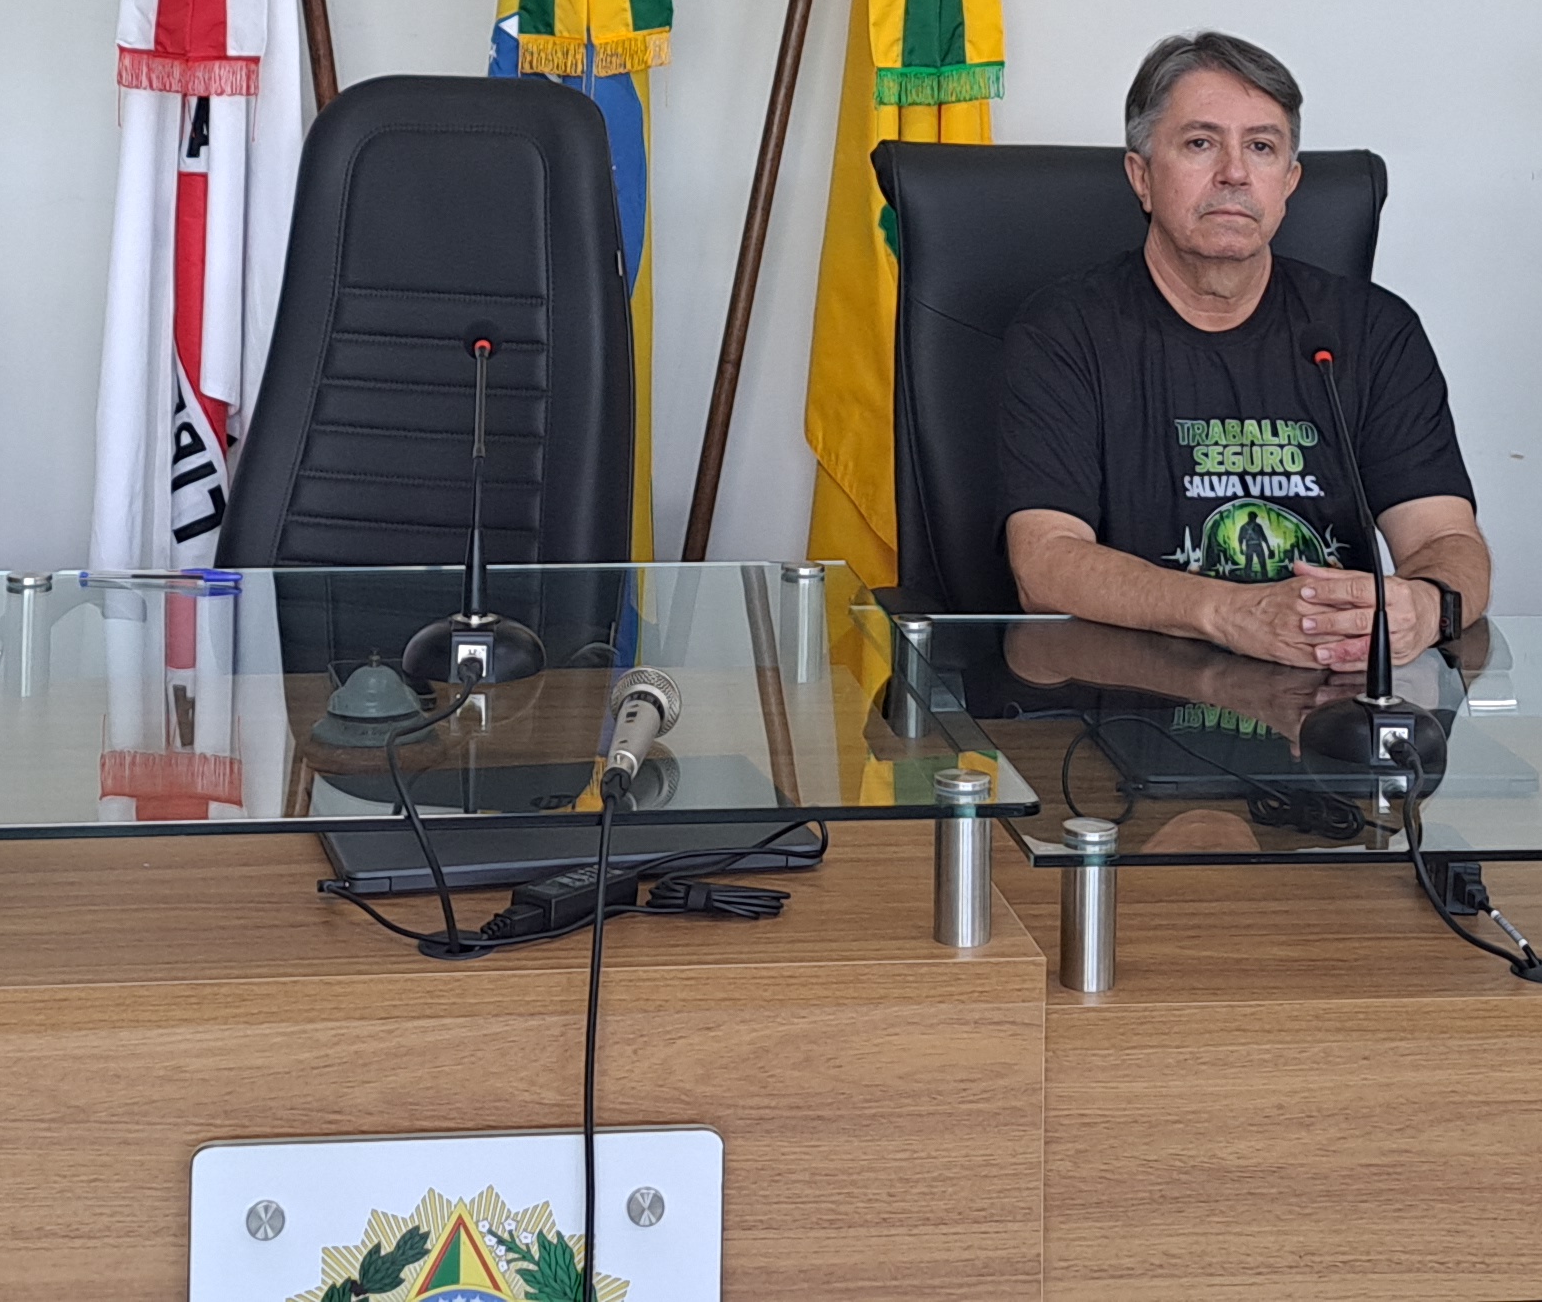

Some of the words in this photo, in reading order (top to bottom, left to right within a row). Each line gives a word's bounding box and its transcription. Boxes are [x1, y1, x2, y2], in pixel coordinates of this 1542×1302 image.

[1174, 419, 1318, 446] TRABALHO
[1193, 445, 1304, 473] SEGURO
[1183, 475, 1244, 498] SALVA
